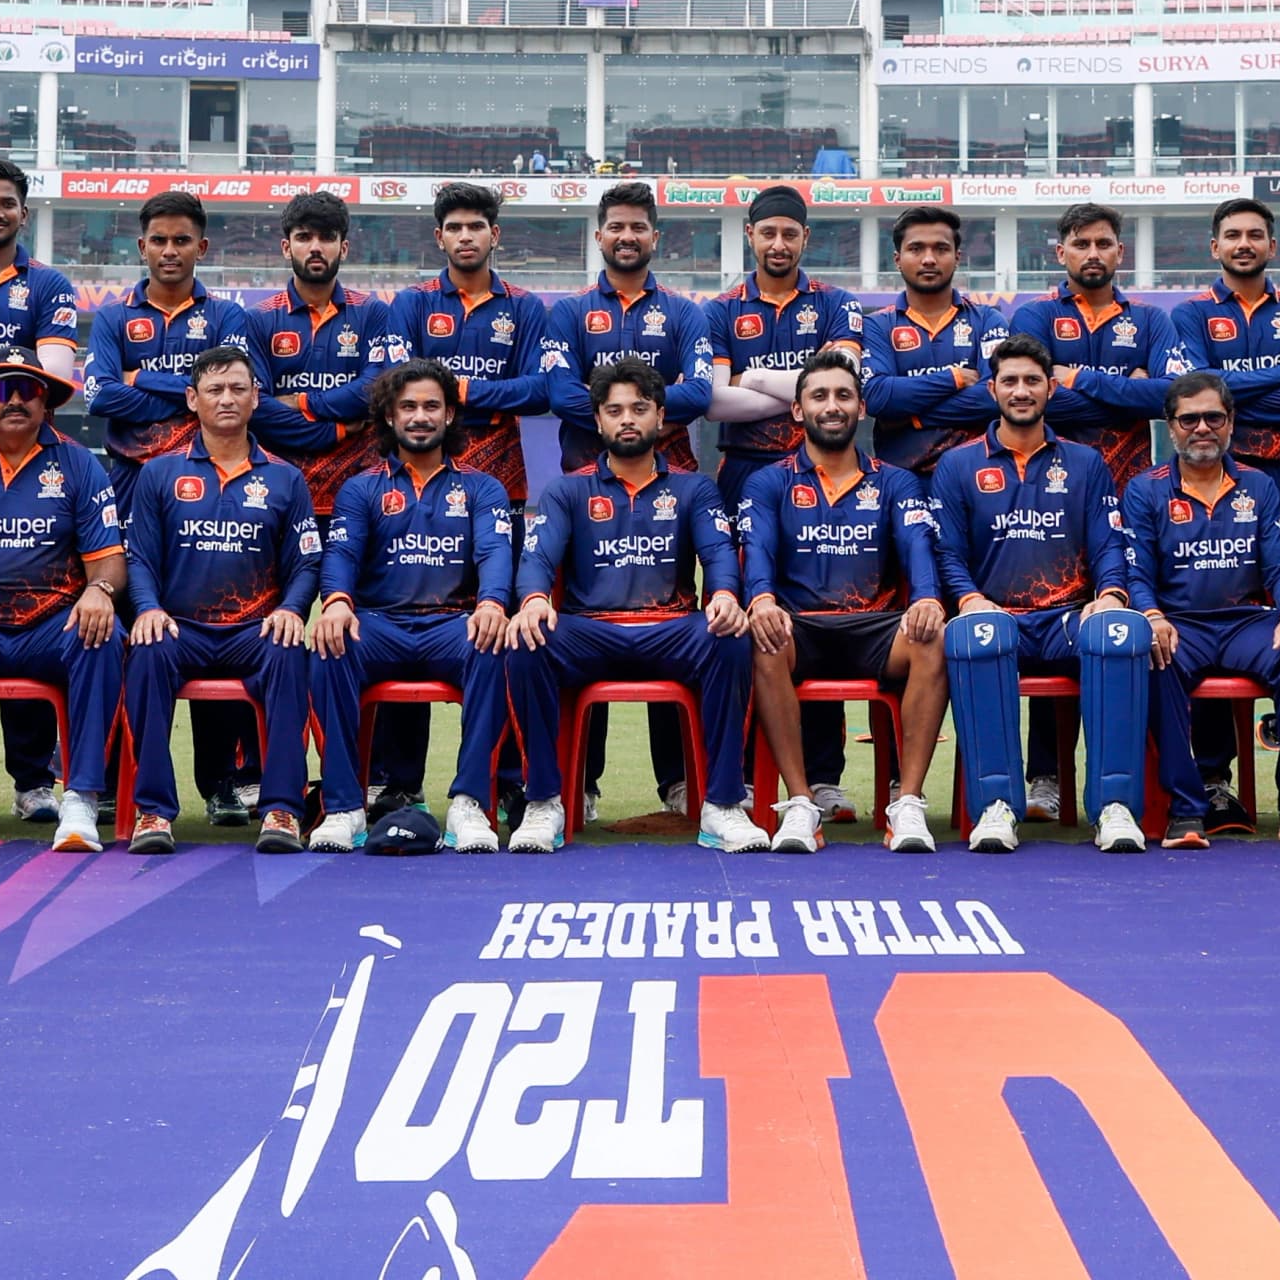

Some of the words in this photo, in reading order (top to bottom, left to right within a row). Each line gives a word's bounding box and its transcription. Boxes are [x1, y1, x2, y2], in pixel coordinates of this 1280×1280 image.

[900, 58, 989, 73] TRENDS
[1035, 57, 1122, 73] TRENDS
[1138, 55, 1209, 72] SURYA
[68, 179, 108, 193] adani
[110, 179, 150, 194] ACC
[169, 180, 209, 195] adani
[212, 180, 251, 196] ACC
[371, 182, 407, 197] NSC
[491, 182, 527, 197] NSC
[551, 183, 587, 197] NSC
[961, 182, 1017, 197] fortune
[1035, 182, 1091, 197] fortune
[1109, 181, 1165, 196] fortune
[1183, 180, 1240, 195] fortune
[196, 539, 243, 553] cement
[399, 553, 444, 566] cement
[1194, 556, 1239, 569] cement
[479, 900, 779, 959] PRADESH
[792, 900, 1024, 955] UTTAR
[355, 980, 704, 1182] T20
